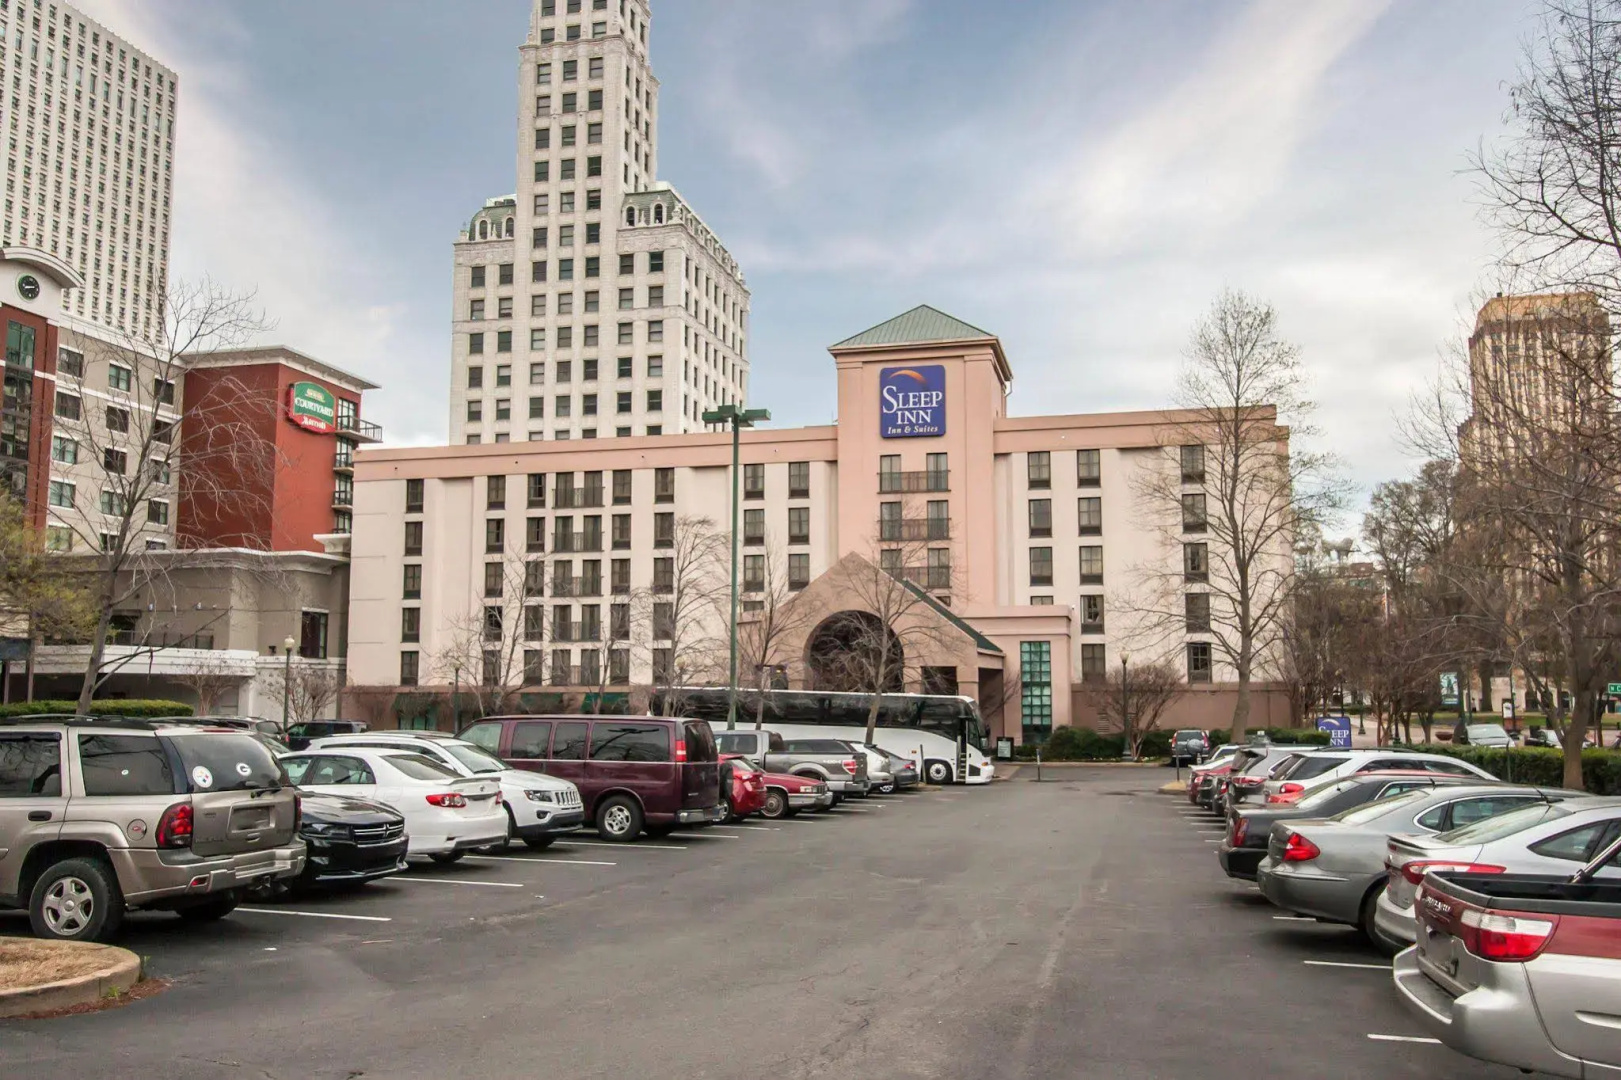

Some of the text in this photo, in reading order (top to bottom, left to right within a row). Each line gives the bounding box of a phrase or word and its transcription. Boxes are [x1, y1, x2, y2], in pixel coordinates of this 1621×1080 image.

[295, 397, 334, 417] COURTYARD
[882, 385, 943, 414] SLEEP
[896, 409, 932, 425] INN
[887, 424, 939, 435] Inn & Suites
